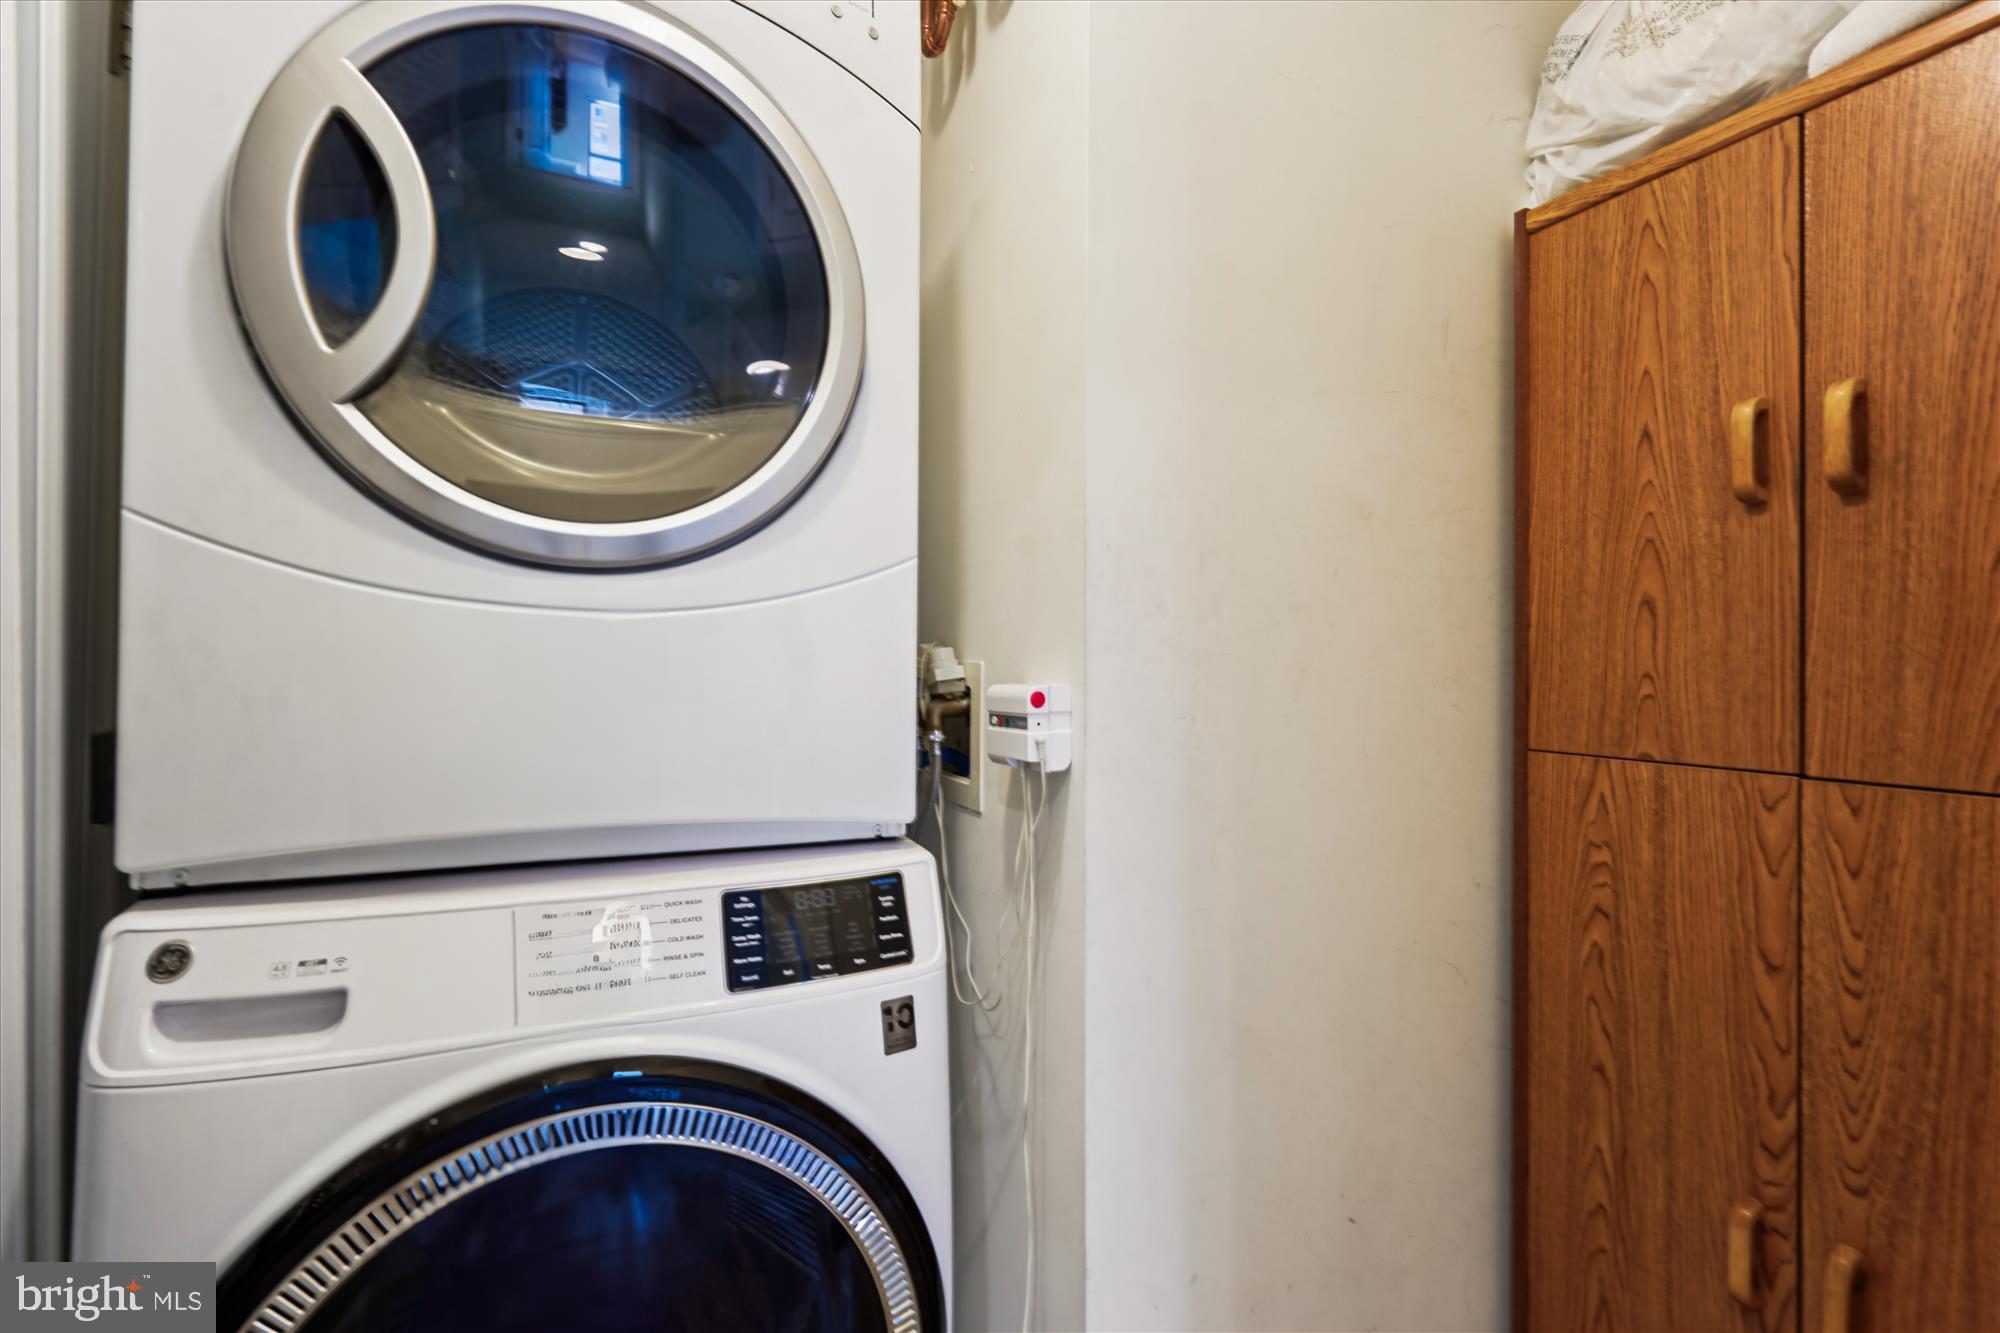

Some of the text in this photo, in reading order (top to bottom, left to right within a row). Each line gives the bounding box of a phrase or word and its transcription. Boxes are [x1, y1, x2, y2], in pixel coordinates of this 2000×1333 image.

[664, 900, 683, 909] QUICK
[669, 915, 703, 925] DELICATES
[666, 935, 685, 943] COLD
[684, 970, 706, 978] CLEAN
